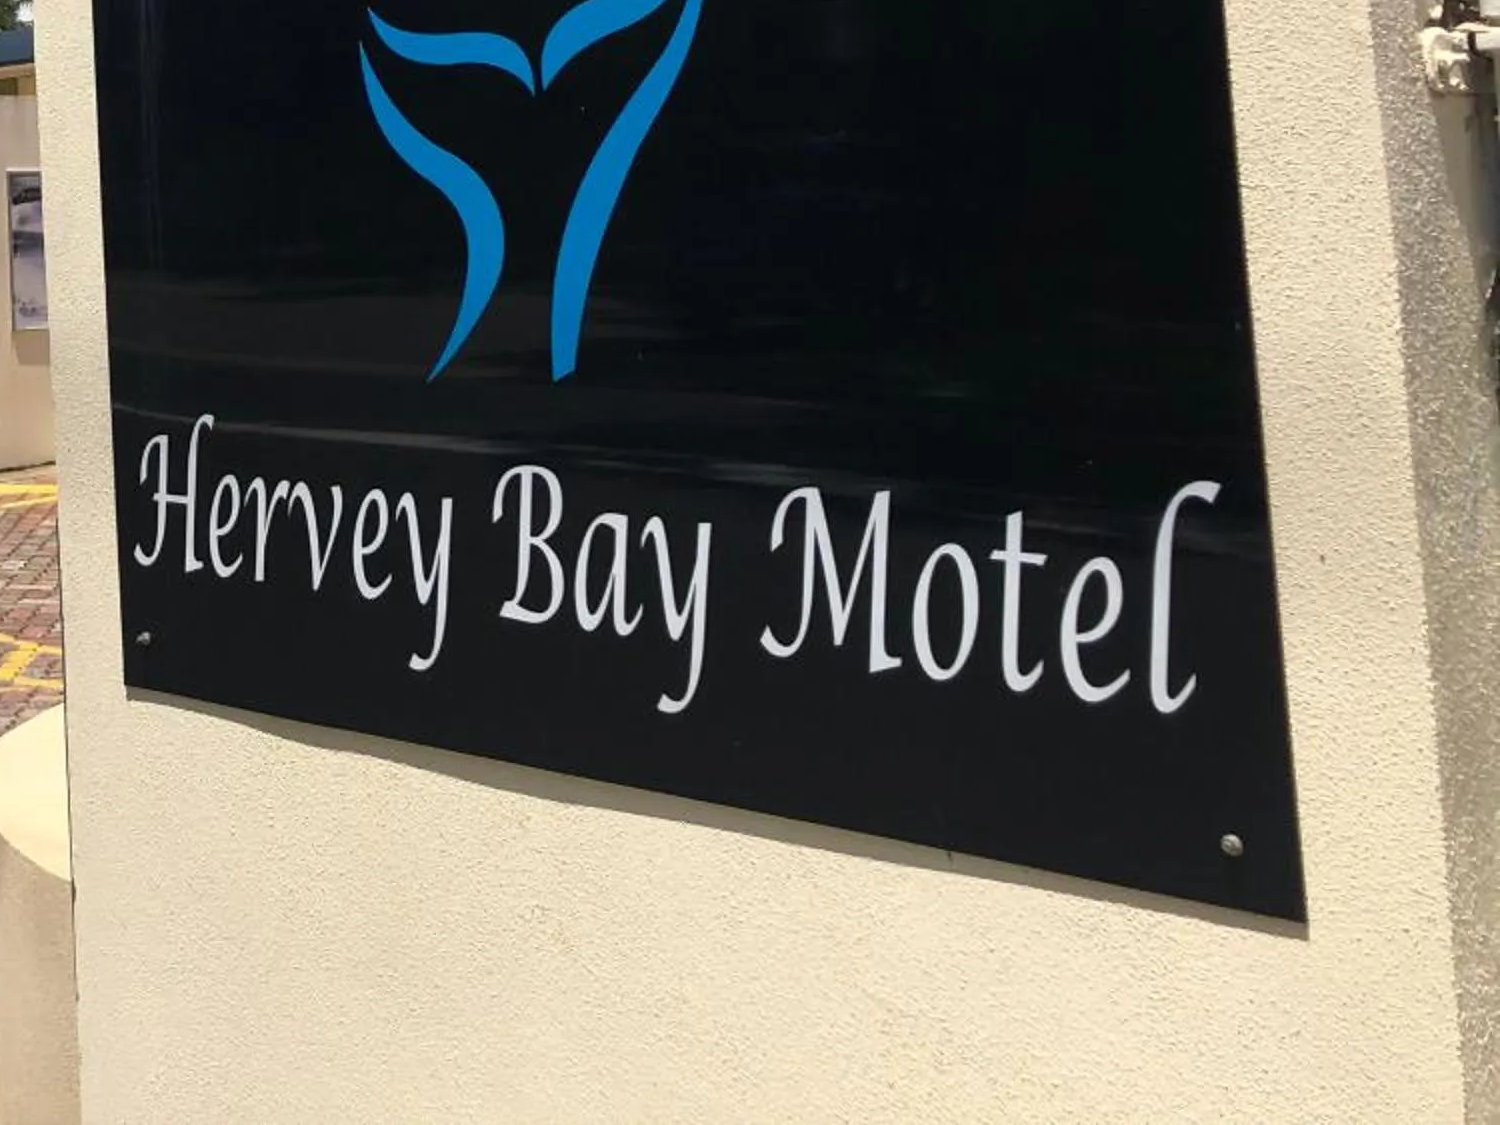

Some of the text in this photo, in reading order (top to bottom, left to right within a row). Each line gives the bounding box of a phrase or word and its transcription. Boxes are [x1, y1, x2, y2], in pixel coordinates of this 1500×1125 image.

[133, 414, 1222, 715] Hervey Bay Motel
